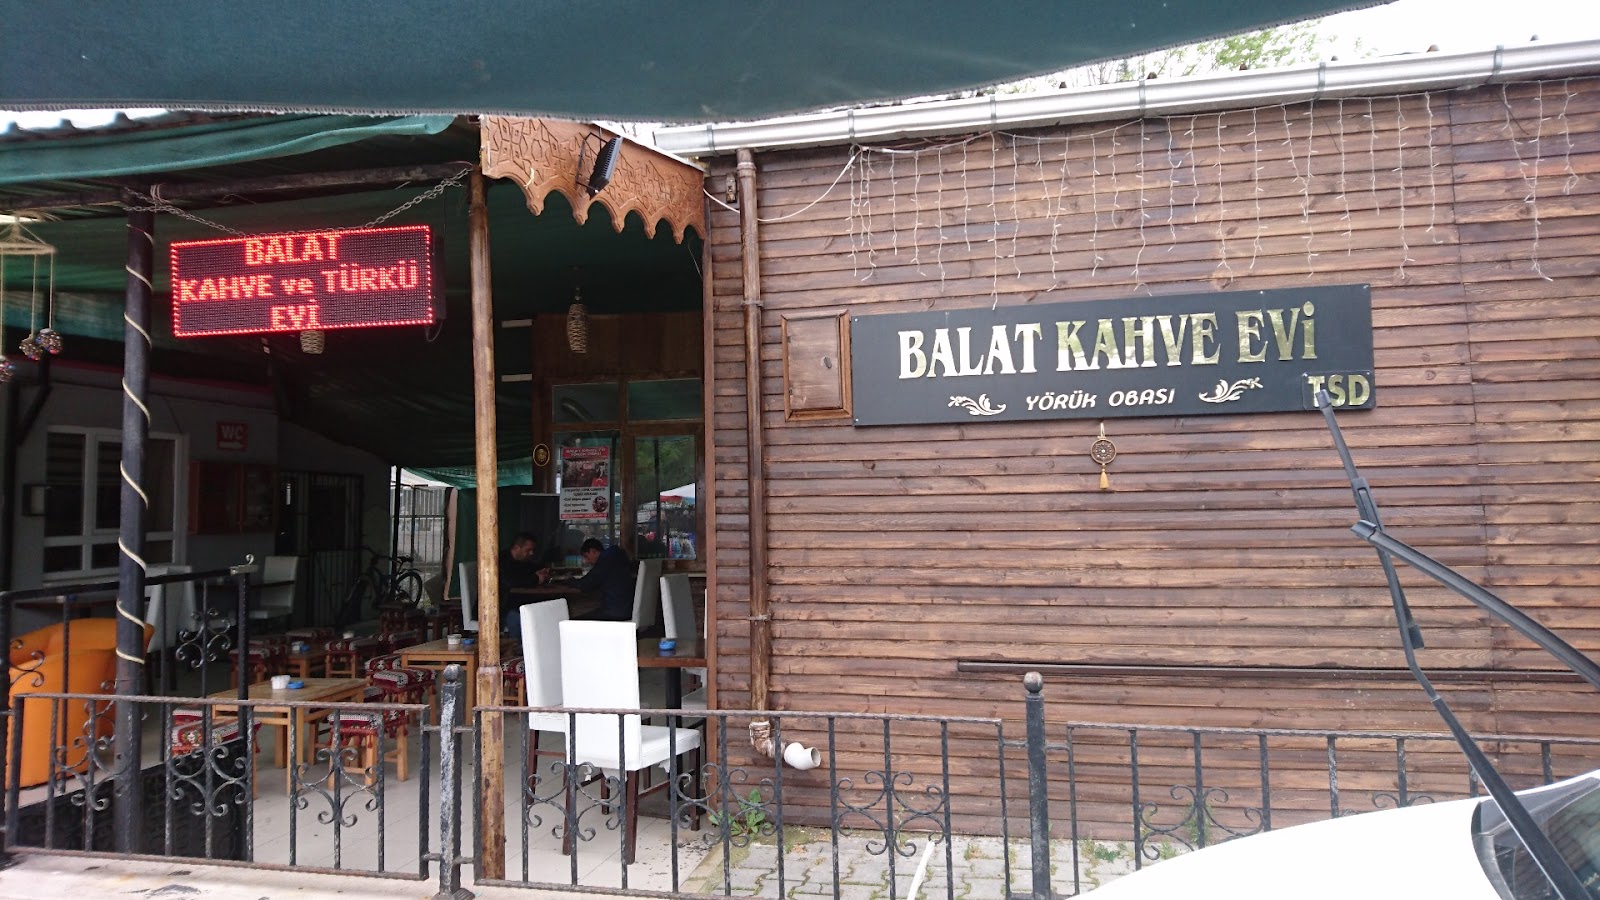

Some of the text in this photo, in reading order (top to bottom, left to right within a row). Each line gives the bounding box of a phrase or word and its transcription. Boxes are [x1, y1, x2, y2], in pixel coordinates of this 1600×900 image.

[244, 233, 341, 266] BALAT
[180, 259, 419, 302] KAHVE ve TÜRKÜ
[269, 299, 321, 330] EVİ
[897, 322, 1043, 380] BALAT
[1055, 311, 1222, 372] KAHVE
[1026, 388, 1177, 411] YÖRÜK OBASI
[1308, 374, 1371, 408] TSD
[221, 424, 244, 440] WC
